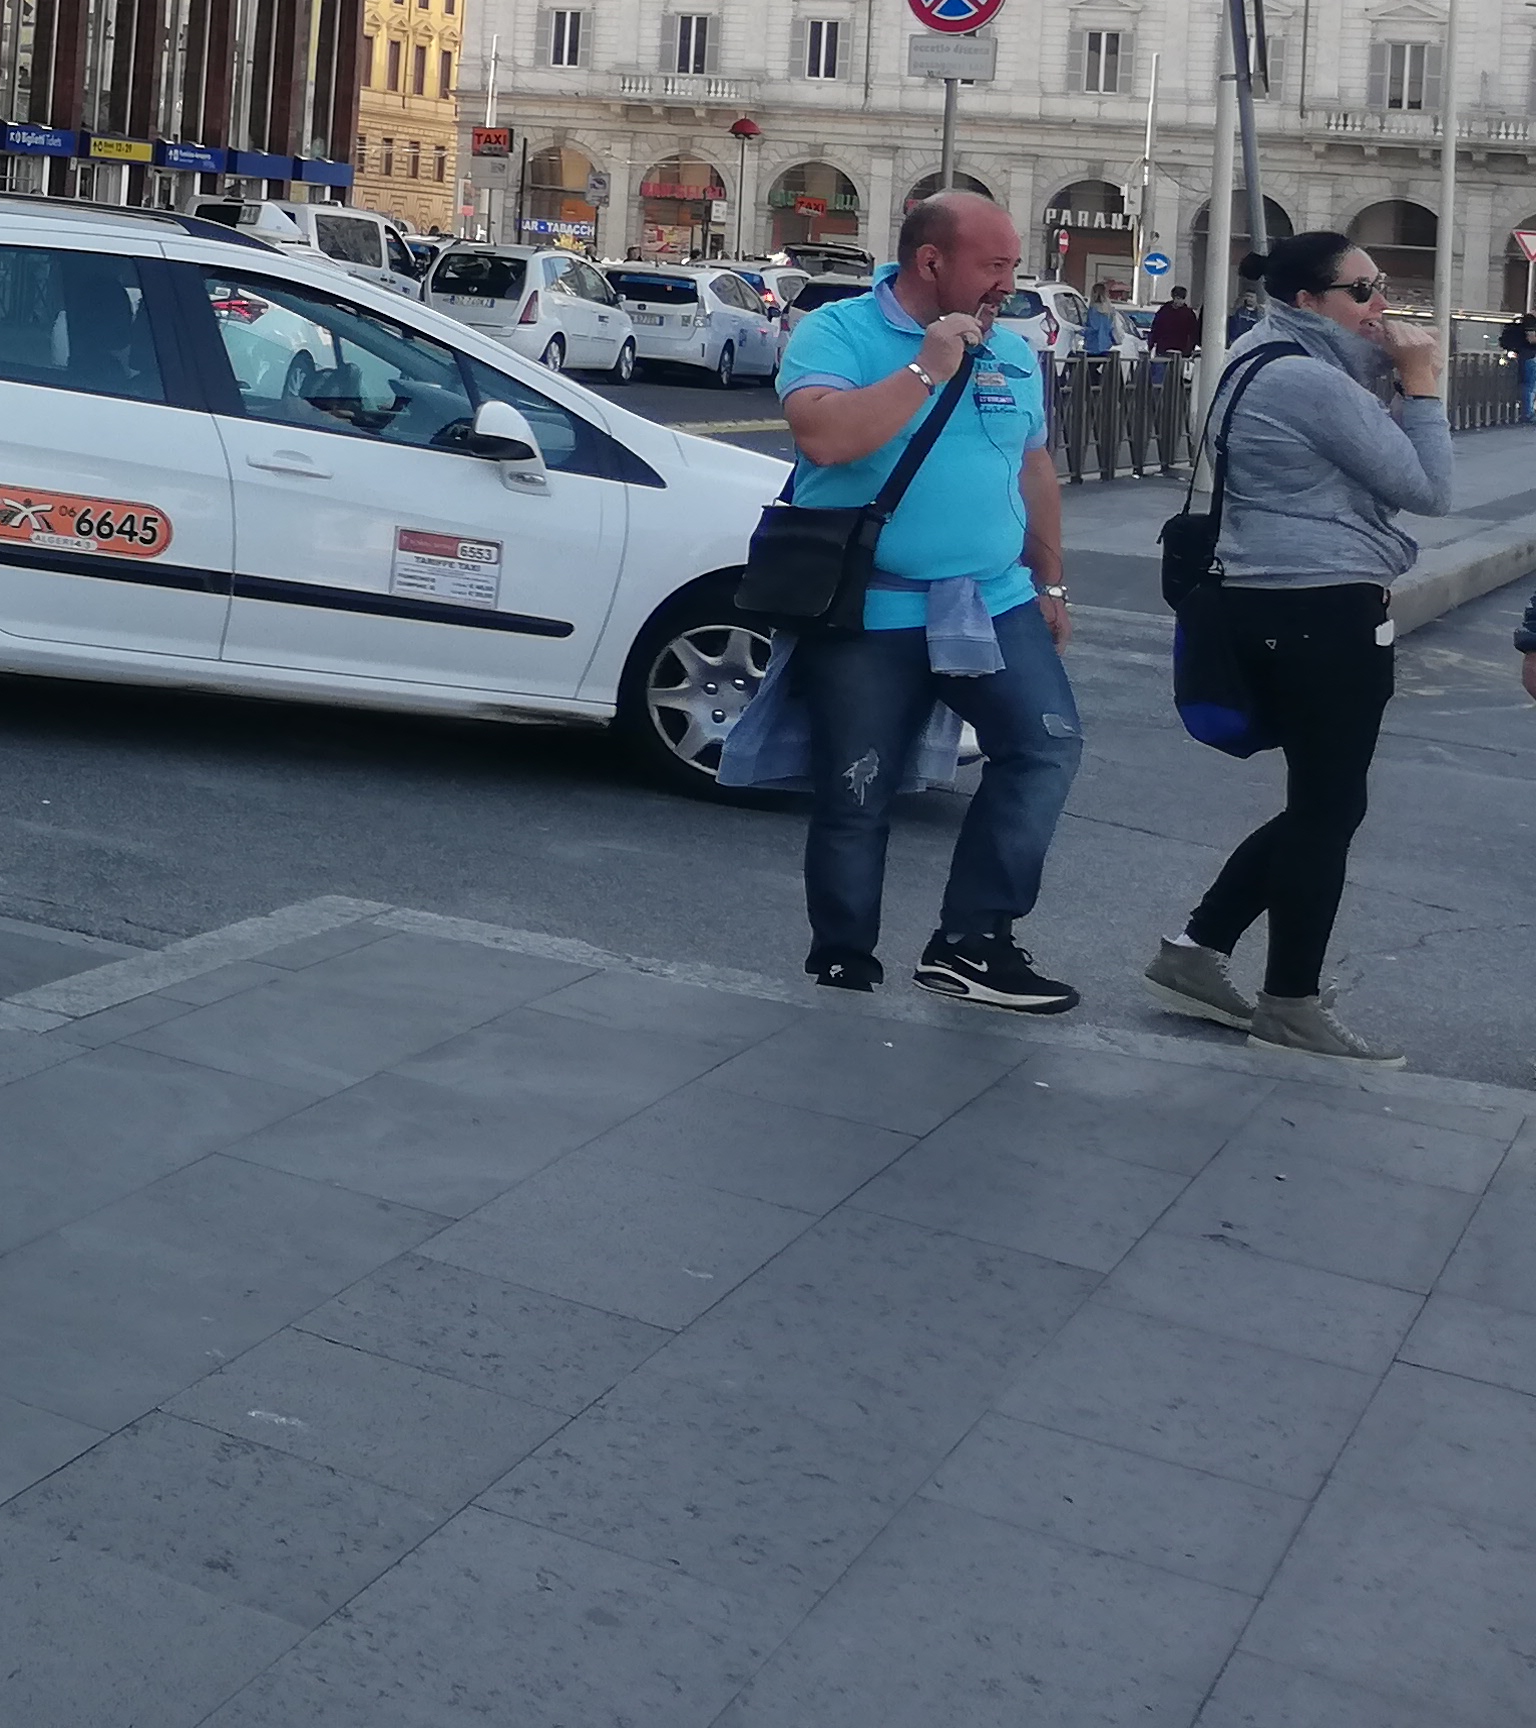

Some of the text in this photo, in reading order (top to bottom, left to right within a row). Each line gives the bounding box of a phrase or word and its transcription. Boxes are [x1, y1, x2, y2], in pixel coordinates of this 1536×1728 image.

[475, 133, 507, 145] TAXI
[798, 200, 825, 212] TAXI
[547, 222, 595, 236] TABACCH
[58, 505, 77, 517] 06
[75, 508, 160, 546] 6645
[459, 545, 493, 561] 6553
[414, 556, 482, 572] TARIFFE TAXI
